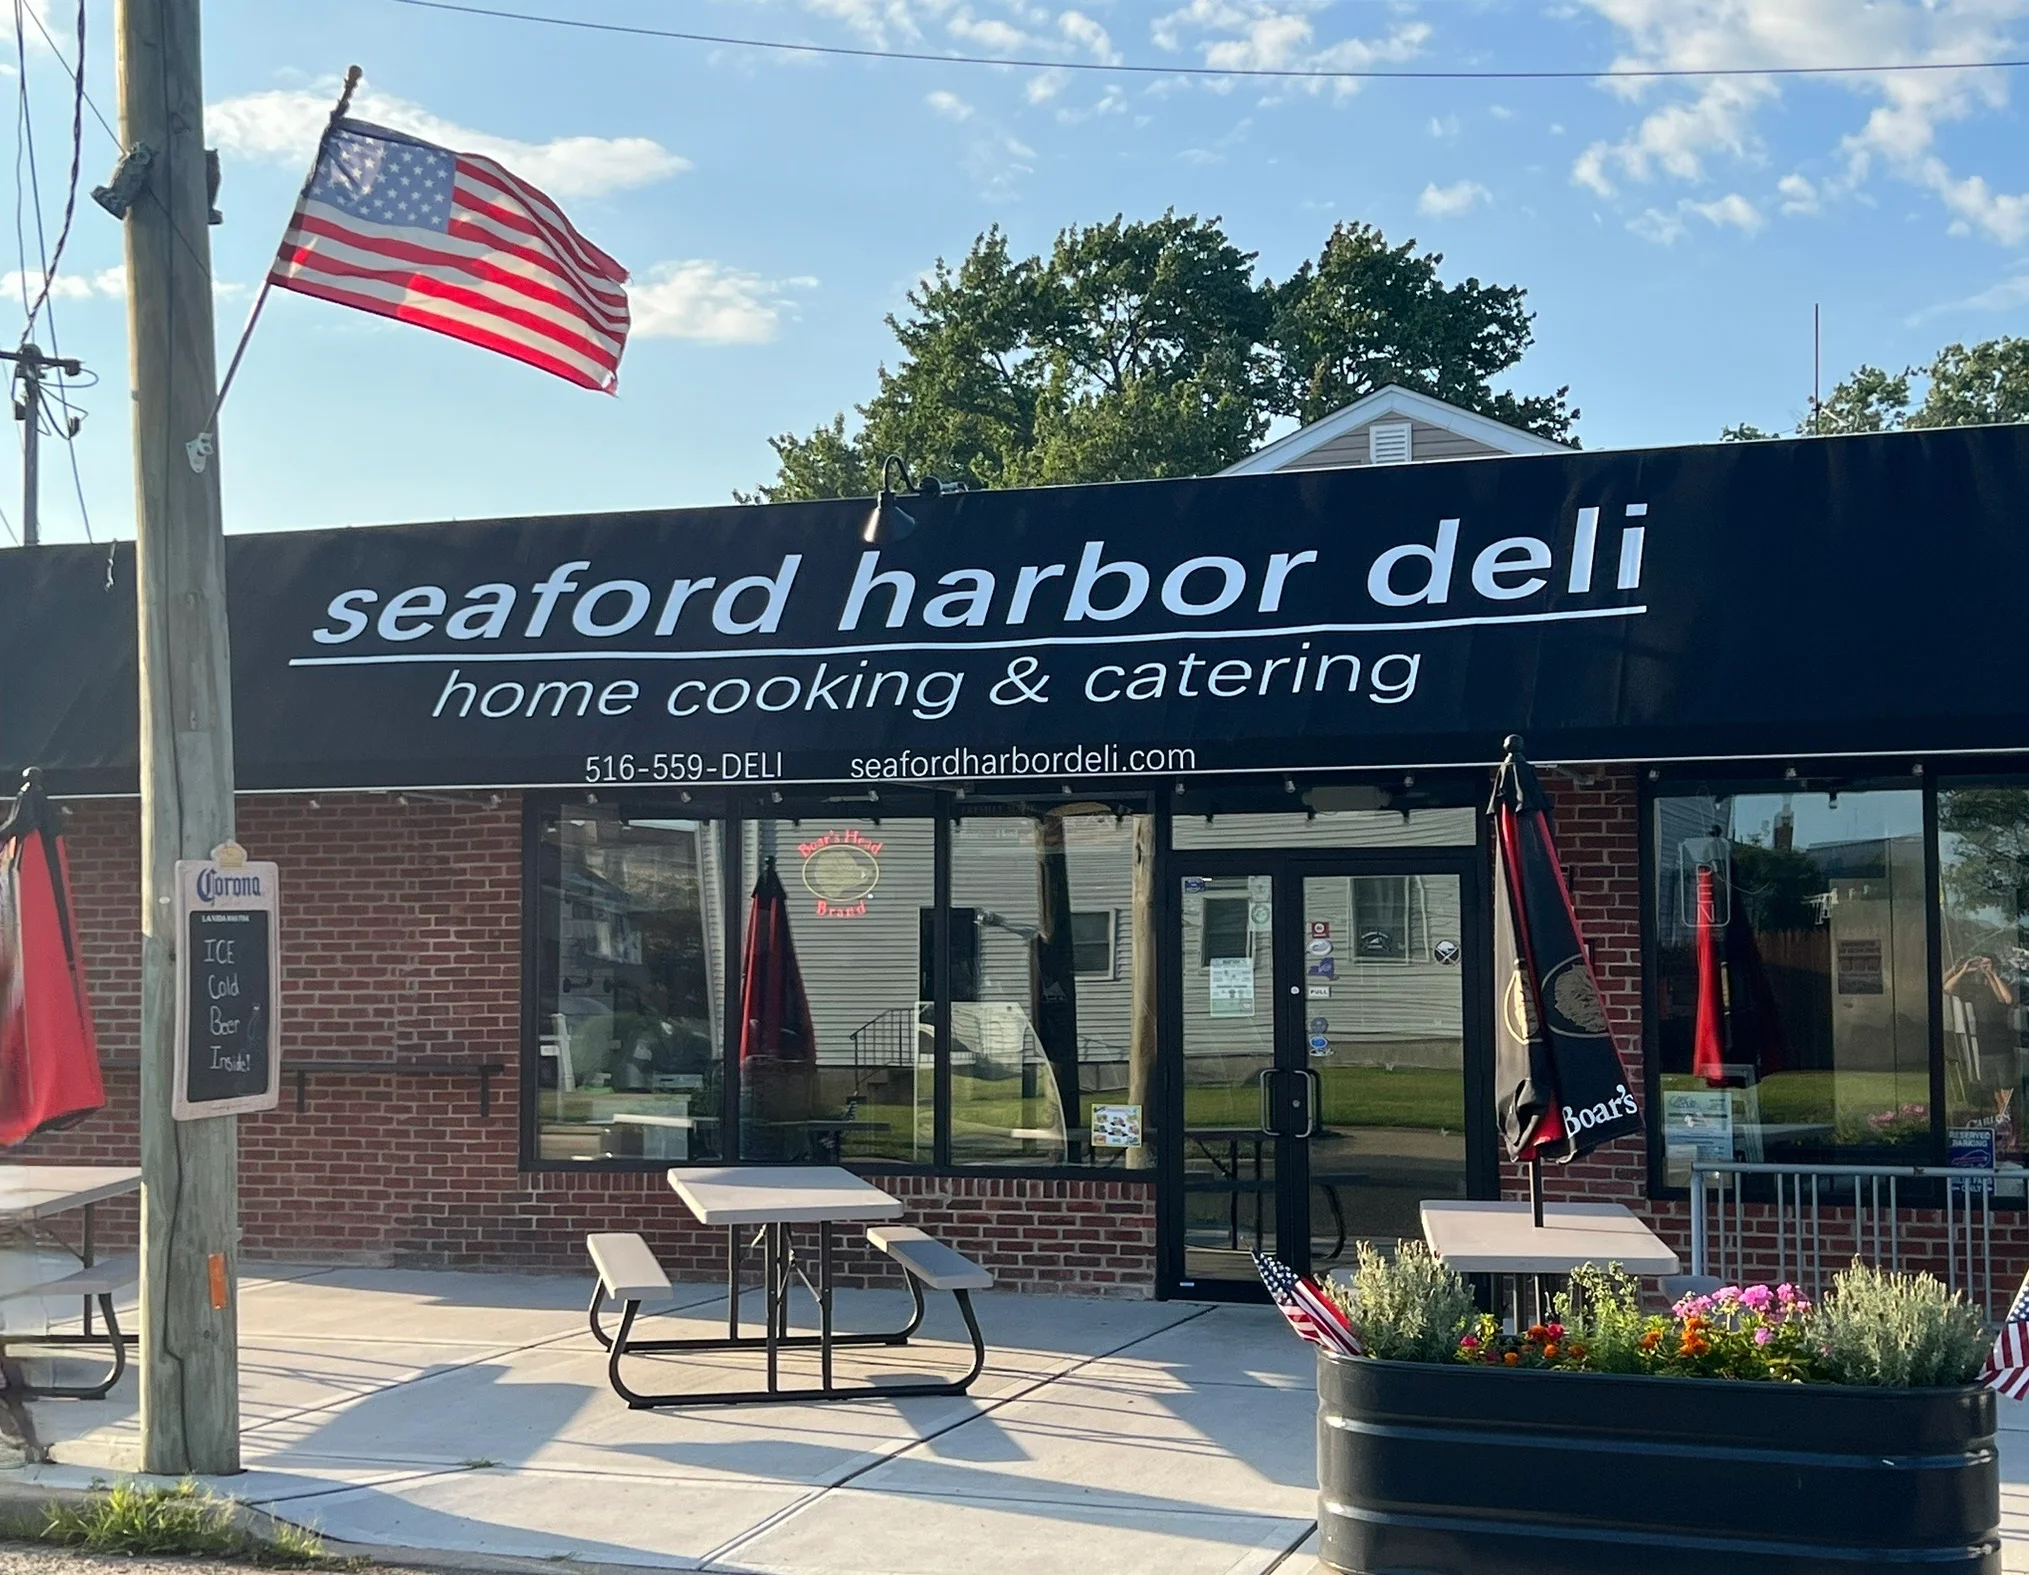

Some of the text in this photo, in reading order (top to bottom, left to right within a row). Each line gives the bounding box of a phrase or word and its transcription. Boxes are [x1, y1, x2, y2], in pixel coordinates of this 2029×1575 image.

[312, 503, 1648, 644] seaford harbor deli
[432, 641, 1421, 720] home cooking & catering
[585, 744, 1195, 783] 516-559-DELI seafordharbordeli.com
[798, 830, 883, 858] Boar's Head
[197, 868, 262, 906] Corona
[817, 900, 866, 917] Brand
[203, 938, 236, 965] ICE
[207, 972, 241, 1000] Cold
[209, 1005, 241, 1036] Beer
[1561, 1084, 1638, 1140] Boar's
